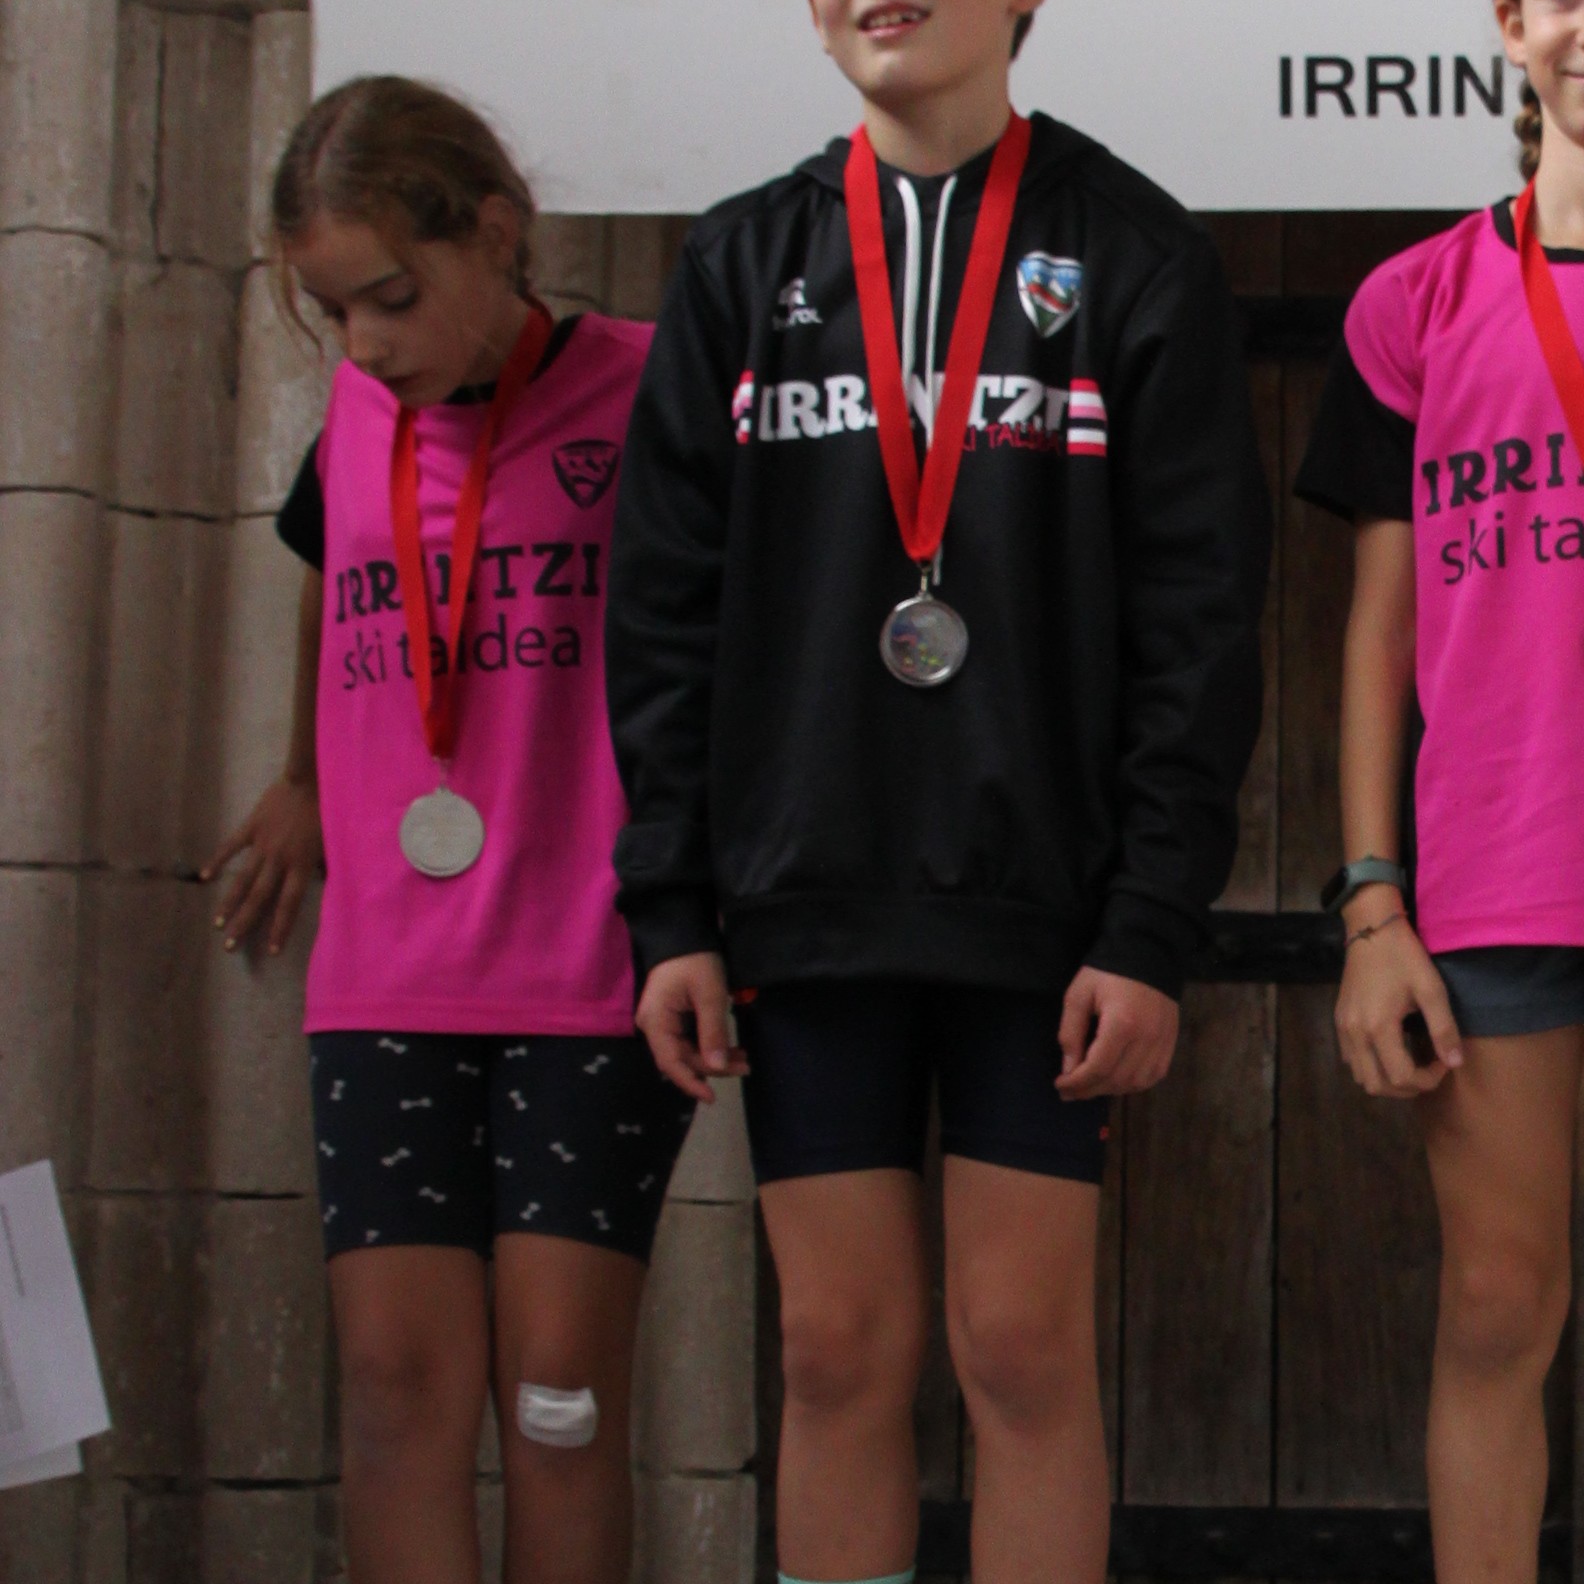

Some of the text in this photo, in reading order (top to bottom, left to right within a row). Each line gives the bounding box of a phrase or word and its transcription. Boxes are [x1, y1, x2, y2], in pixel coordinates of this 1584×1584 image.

[1279, 56, 1505, 117] IRRIN
[1441, 511, 1504, 585] ski
[344, 628, 386, 690] ski
